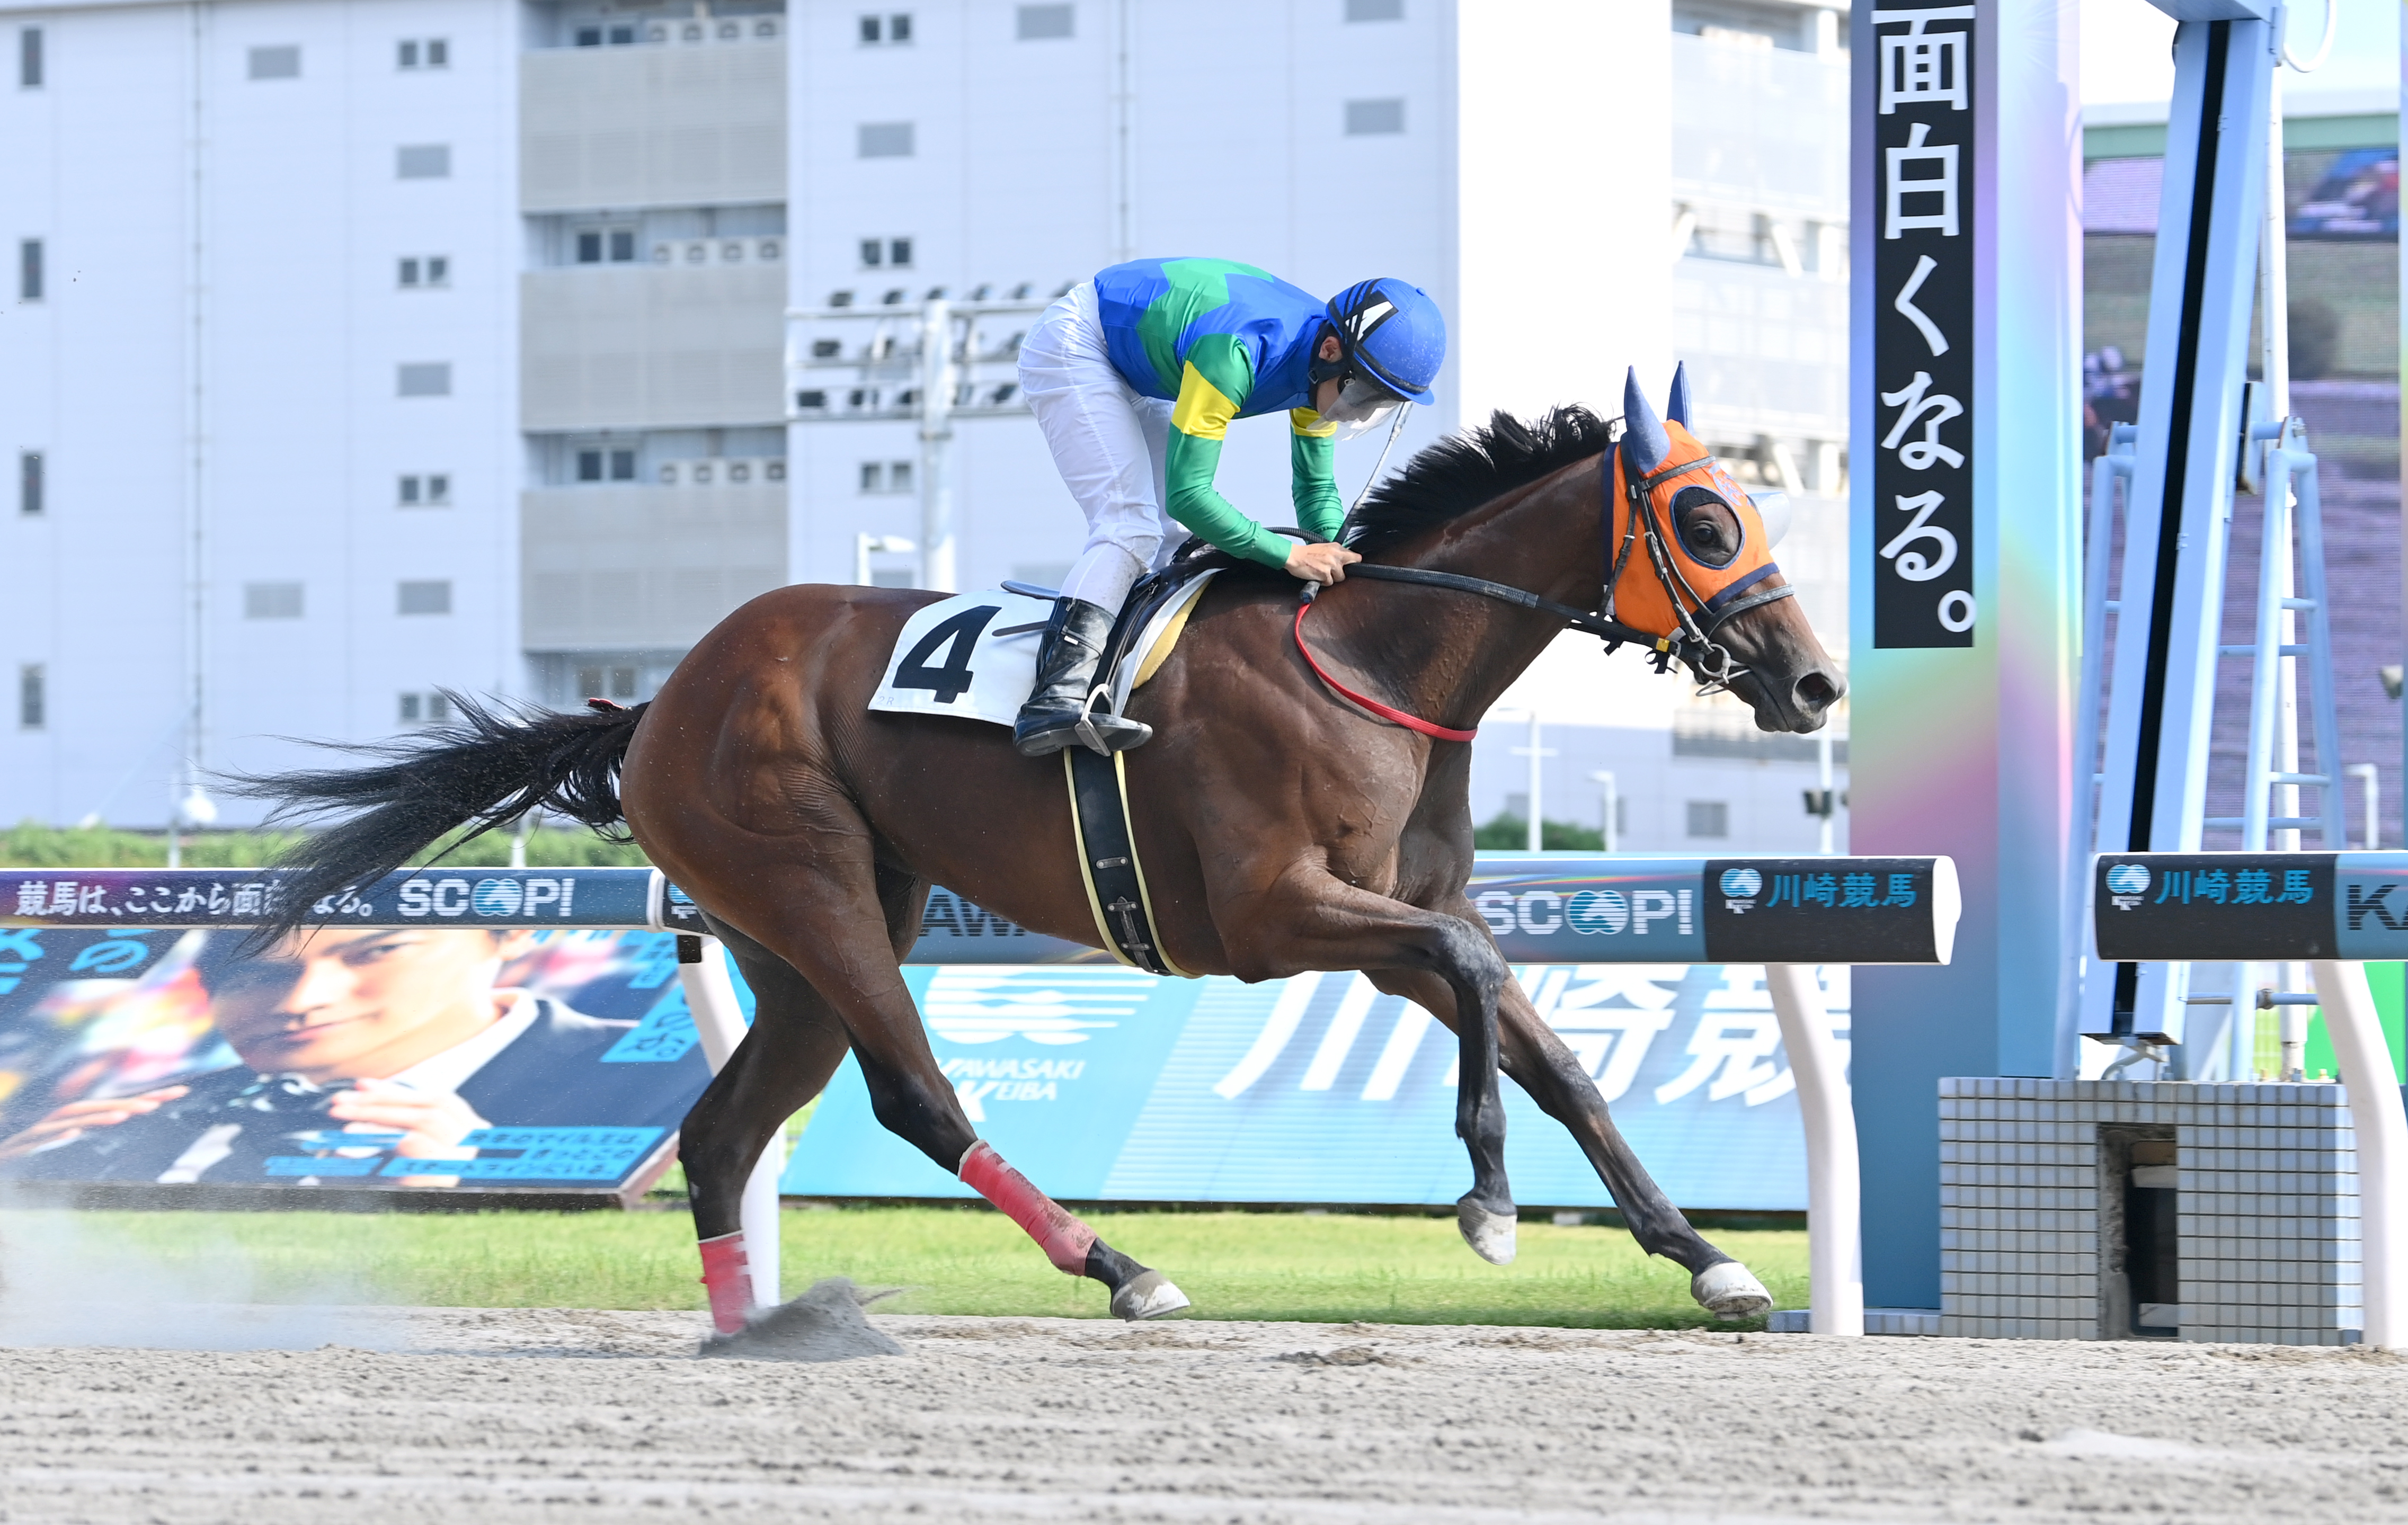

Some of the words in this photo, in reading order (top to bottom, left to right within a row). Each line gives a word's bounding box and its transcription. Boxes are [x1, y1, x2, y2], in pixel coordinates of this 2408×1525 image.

[1871, 5, 1976, 632] 面白くなる。
[892, 605, 1002, 703] 4
[1765, 872, 1917, 907] 川崎競馬
[2154, 869, 2314, 904] 川崎競馬
[2347, 885, 2408, 930] K
